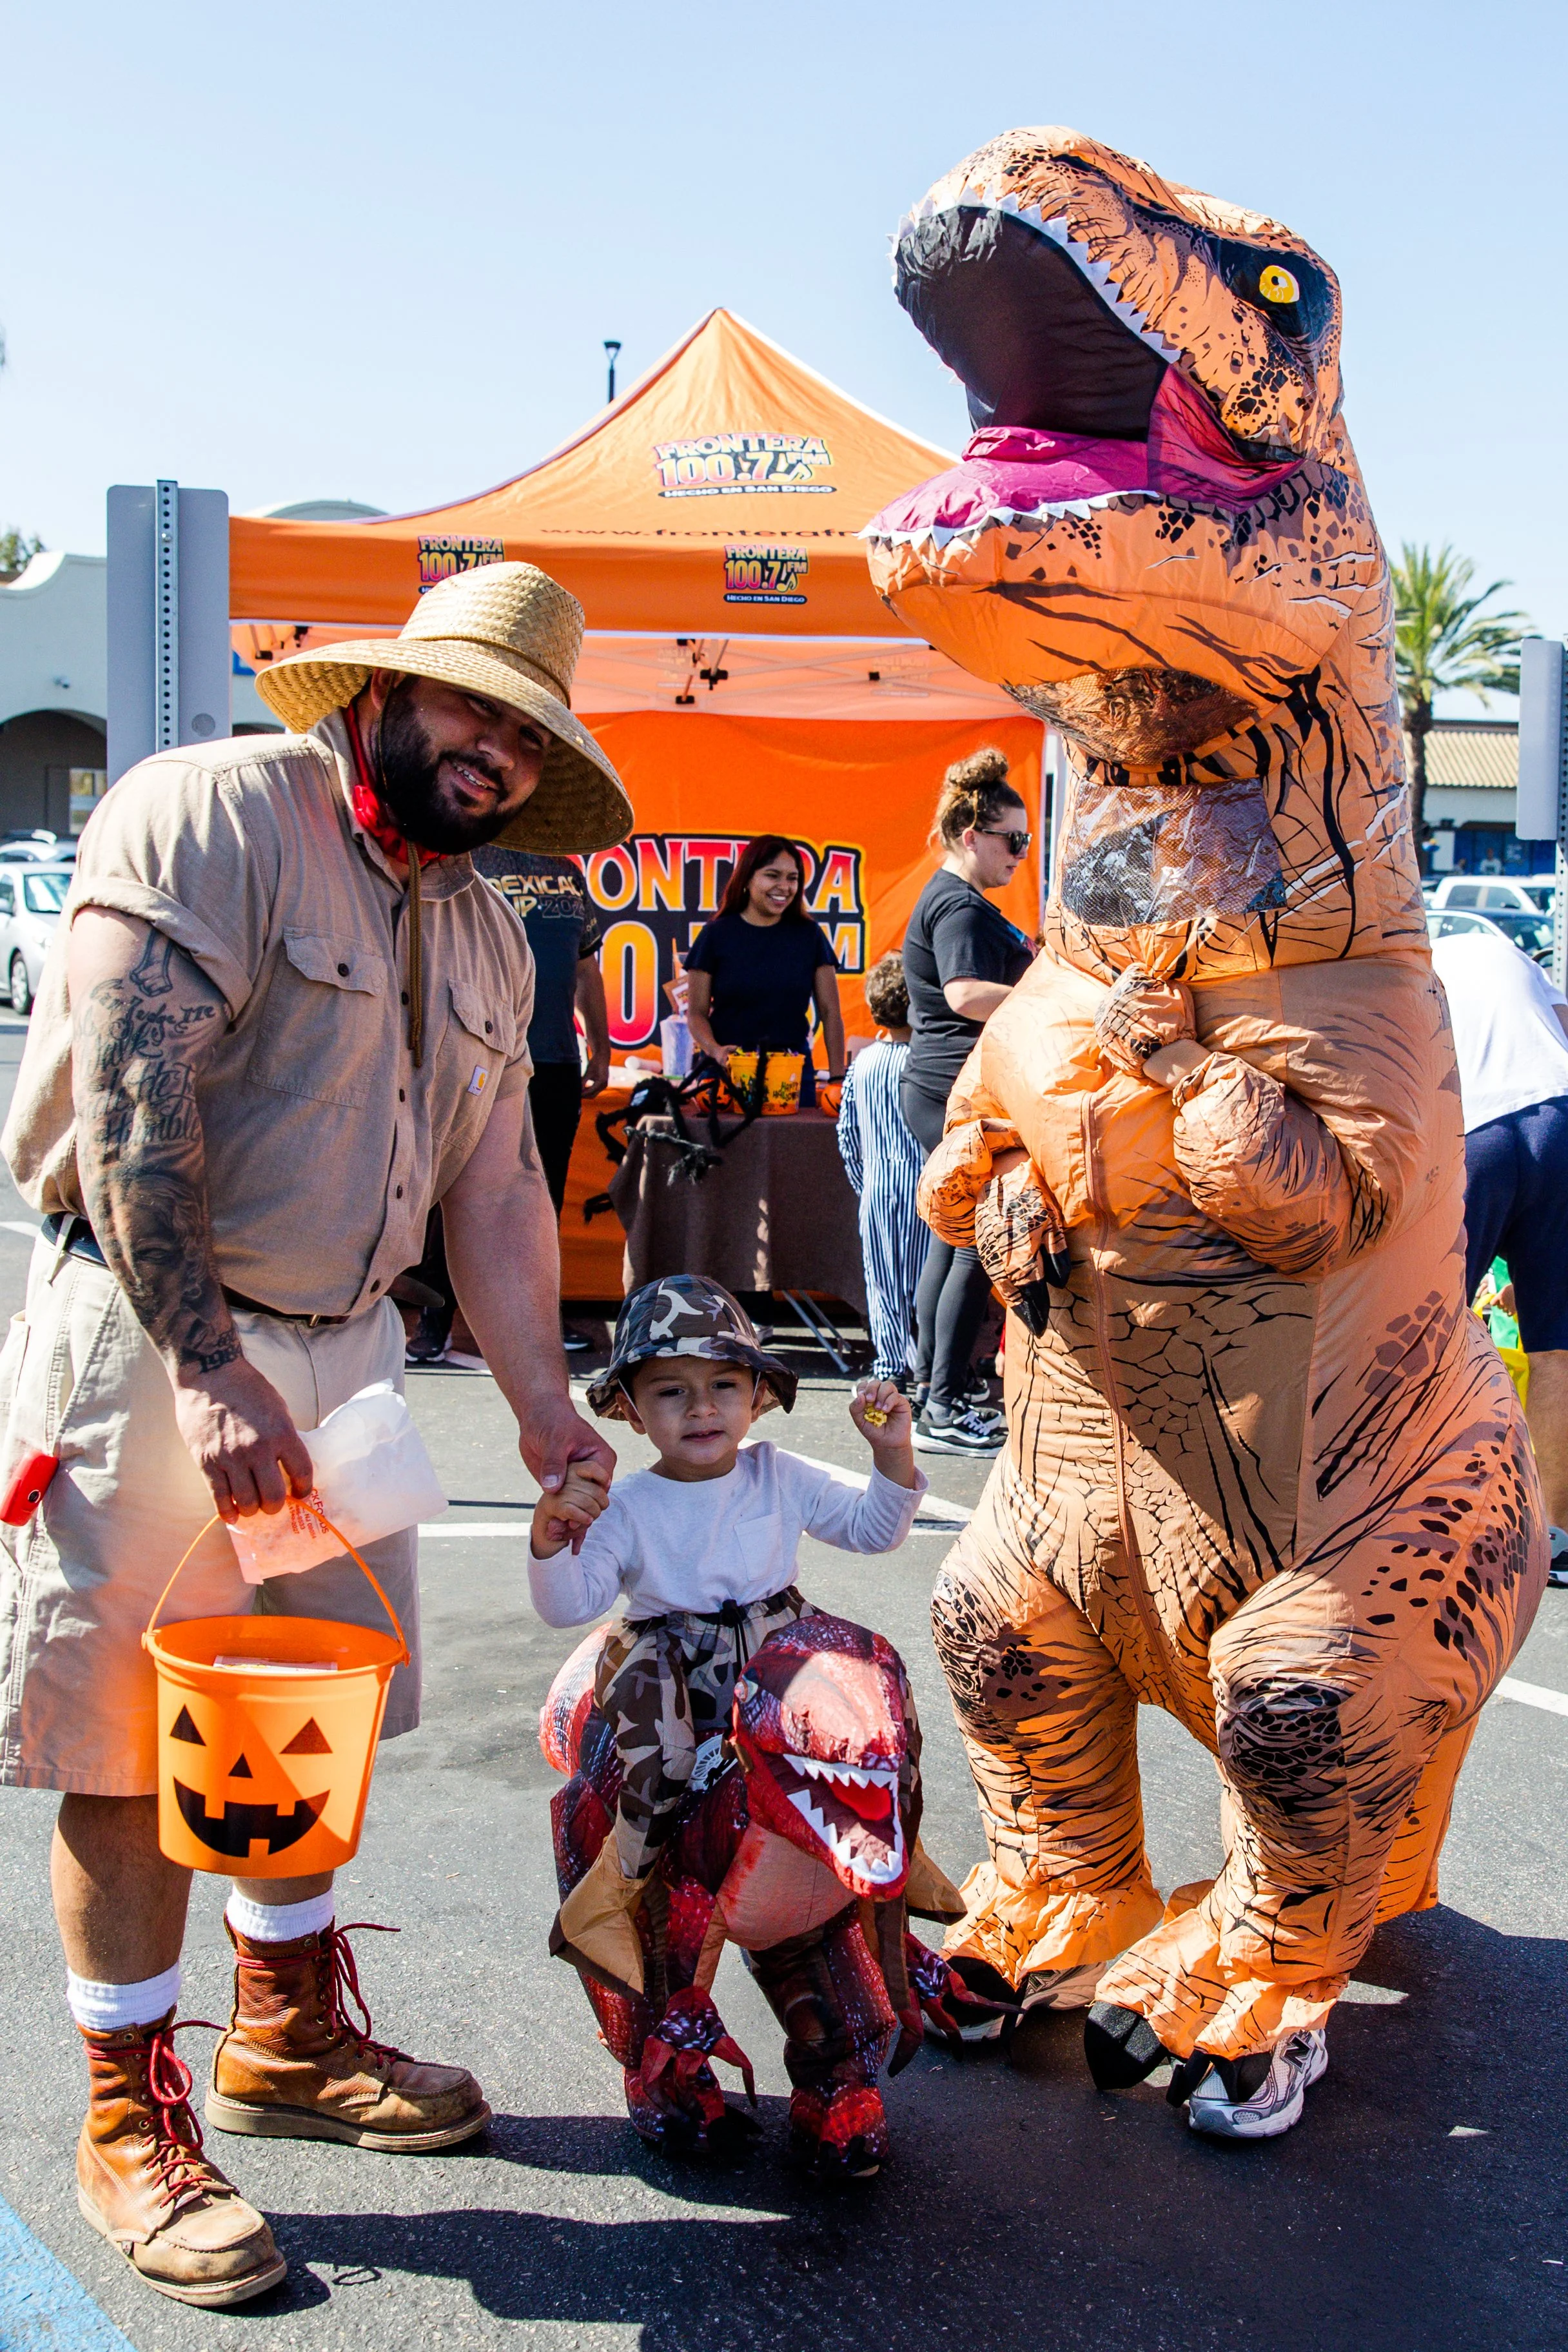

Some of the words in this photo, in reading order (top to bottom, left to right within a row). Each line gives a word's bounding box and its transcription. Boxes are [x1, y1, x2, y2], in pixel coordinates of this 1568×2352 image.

[655, 433, 826, 459] FRONTERA
[656, 451, 774, 486] 100.7
[786, 452, 830, 465] FM
[664, 488, 720, 497] HECHO
[744, 485, 779, 493] SAN
[781, 485, 833, 493] DIEGO
[419, 536, 503, 553] FRONTERA
[725, 545, 807, 560] FRONTERA
[725, 560, 781, 589] 100.7
[787, 562, 807, 573] FM
